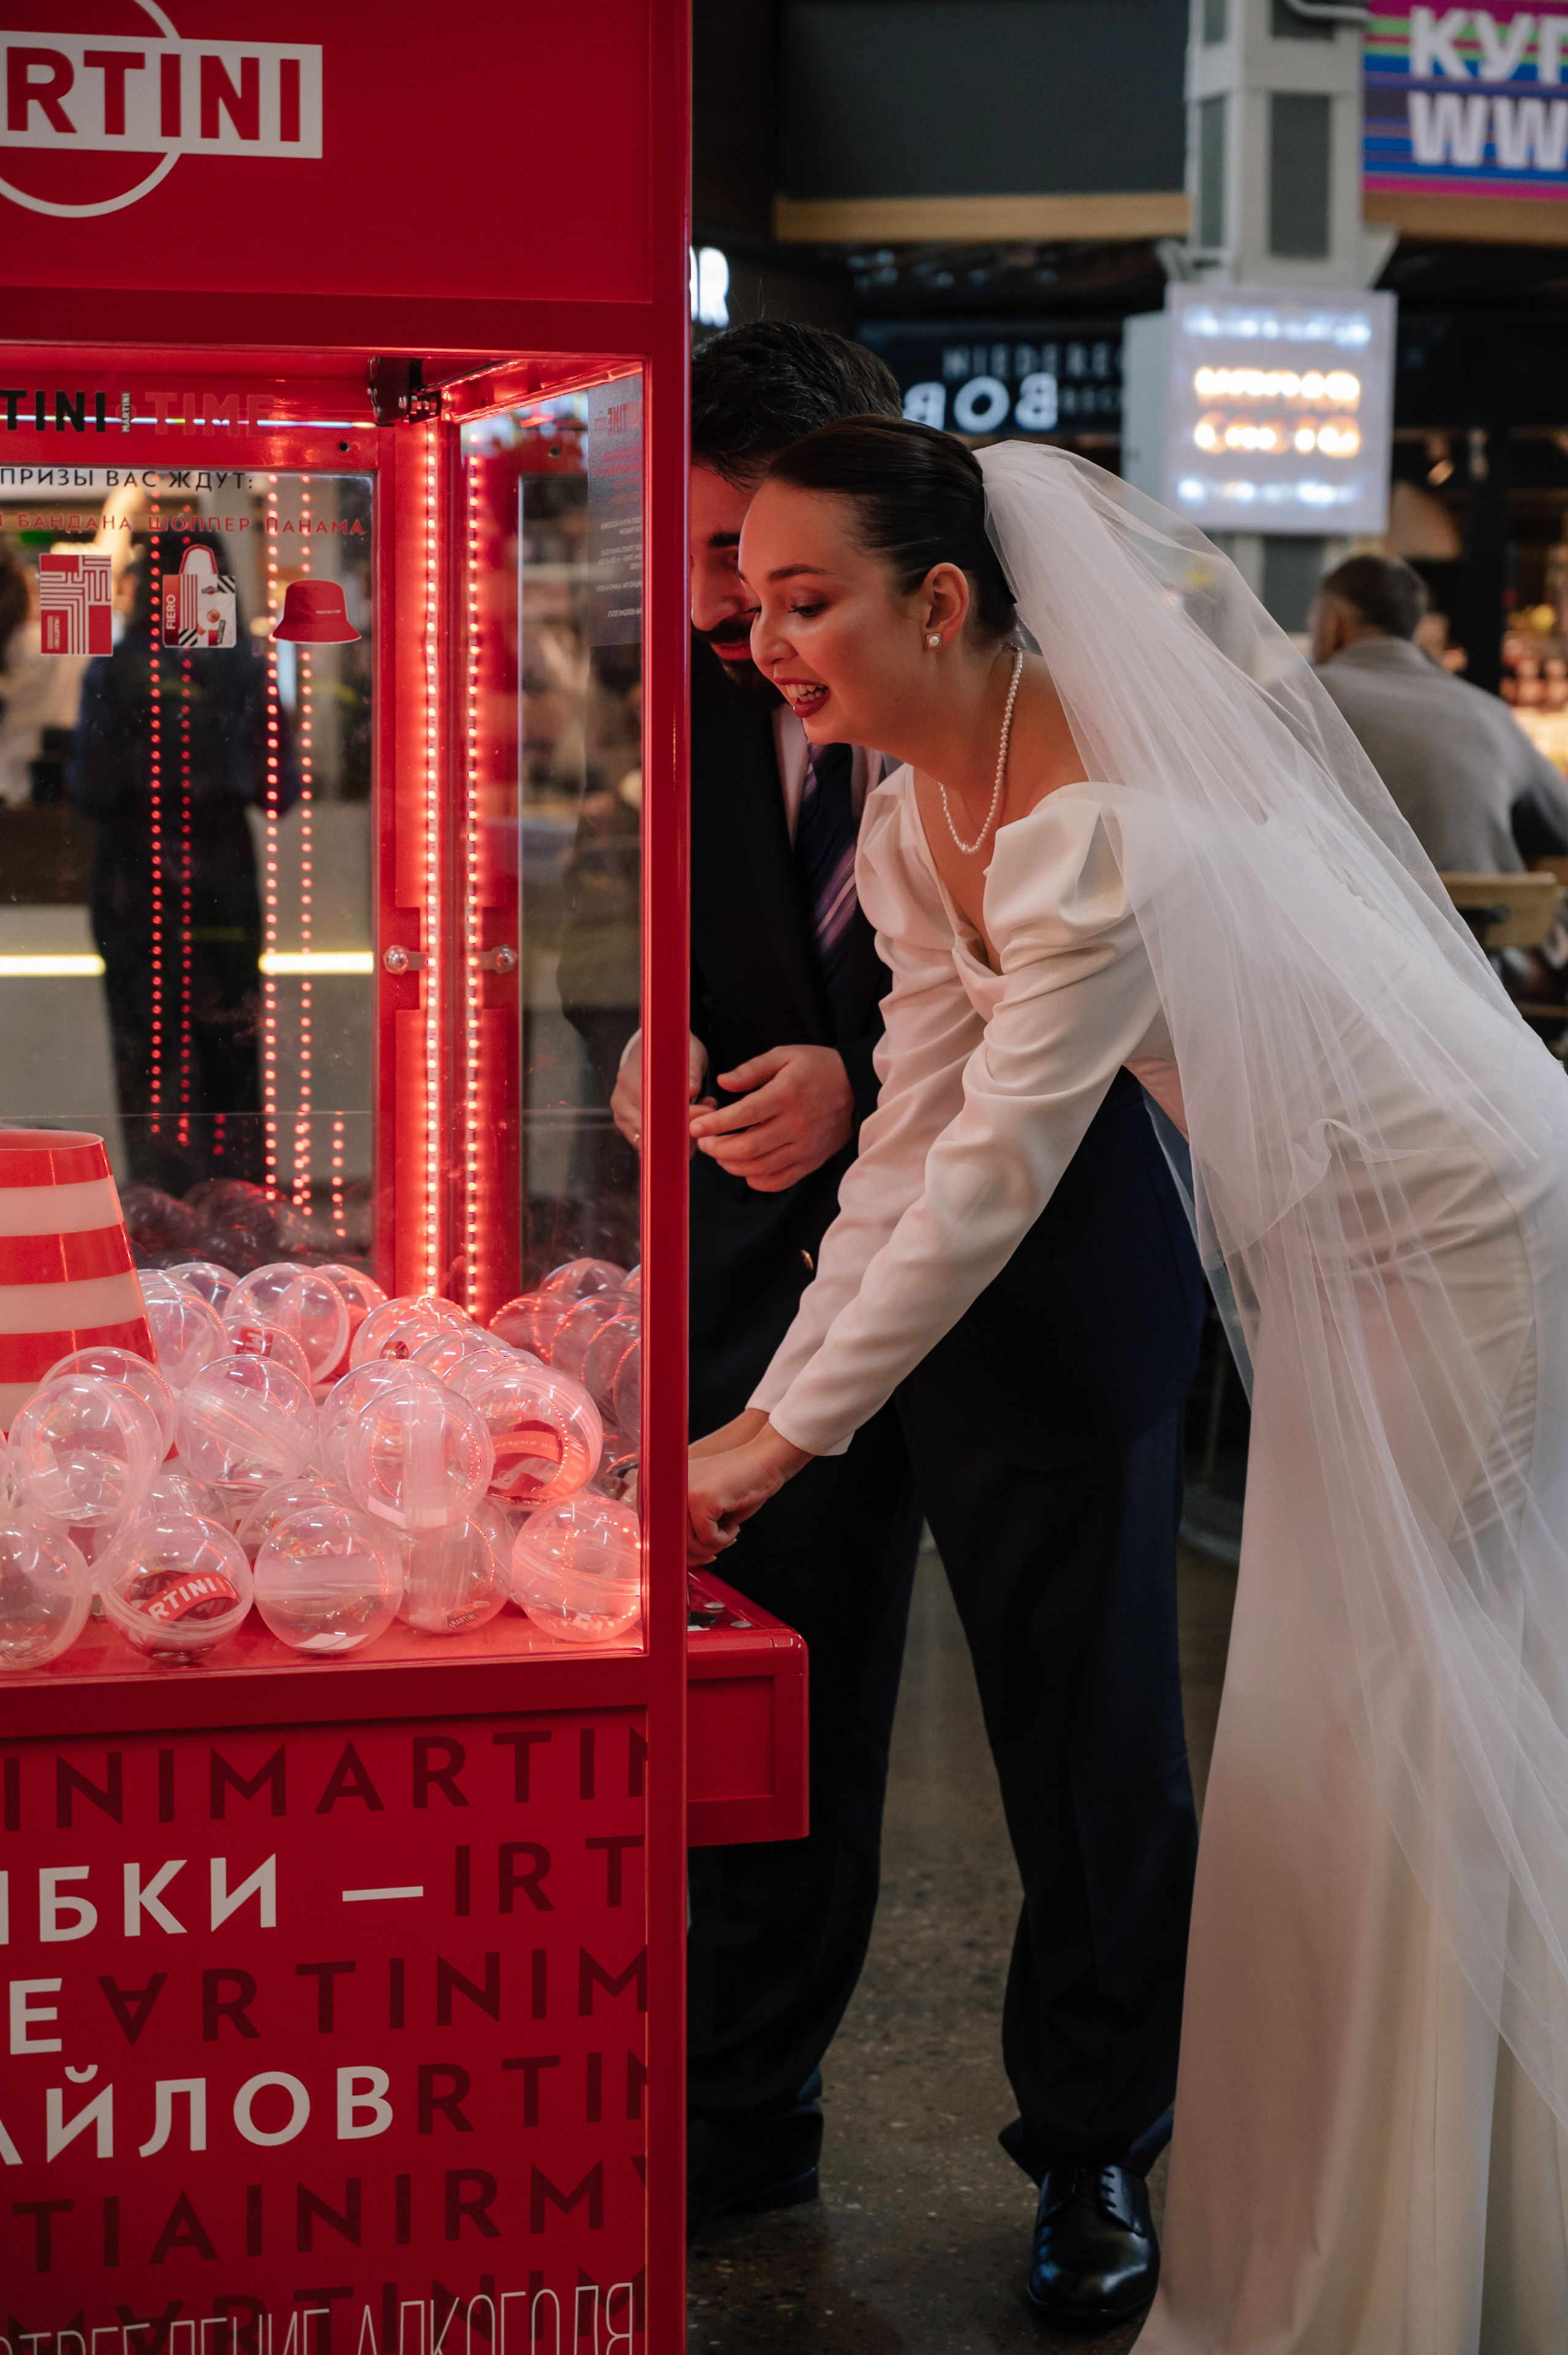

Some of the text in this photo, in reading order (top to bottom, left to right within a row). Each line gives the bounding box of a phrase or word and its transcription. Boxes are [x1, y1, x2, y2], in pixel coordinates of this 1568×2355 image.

[7, 47, 300, 142] RTINI
[145, 391, 276, 437] TIME
[0, 467, 253, 491] ПРИЗЫ ВАС ЖДУТ:
[18, 513, 132, 533] БАНДАНА
[148, 515, 251, 532] ШОППЕР
[265, 518, 365, 535] ПАНАМА
[166, 594, 176, 630] FIERO
[0, 1853, 276, 1945] БКИ
